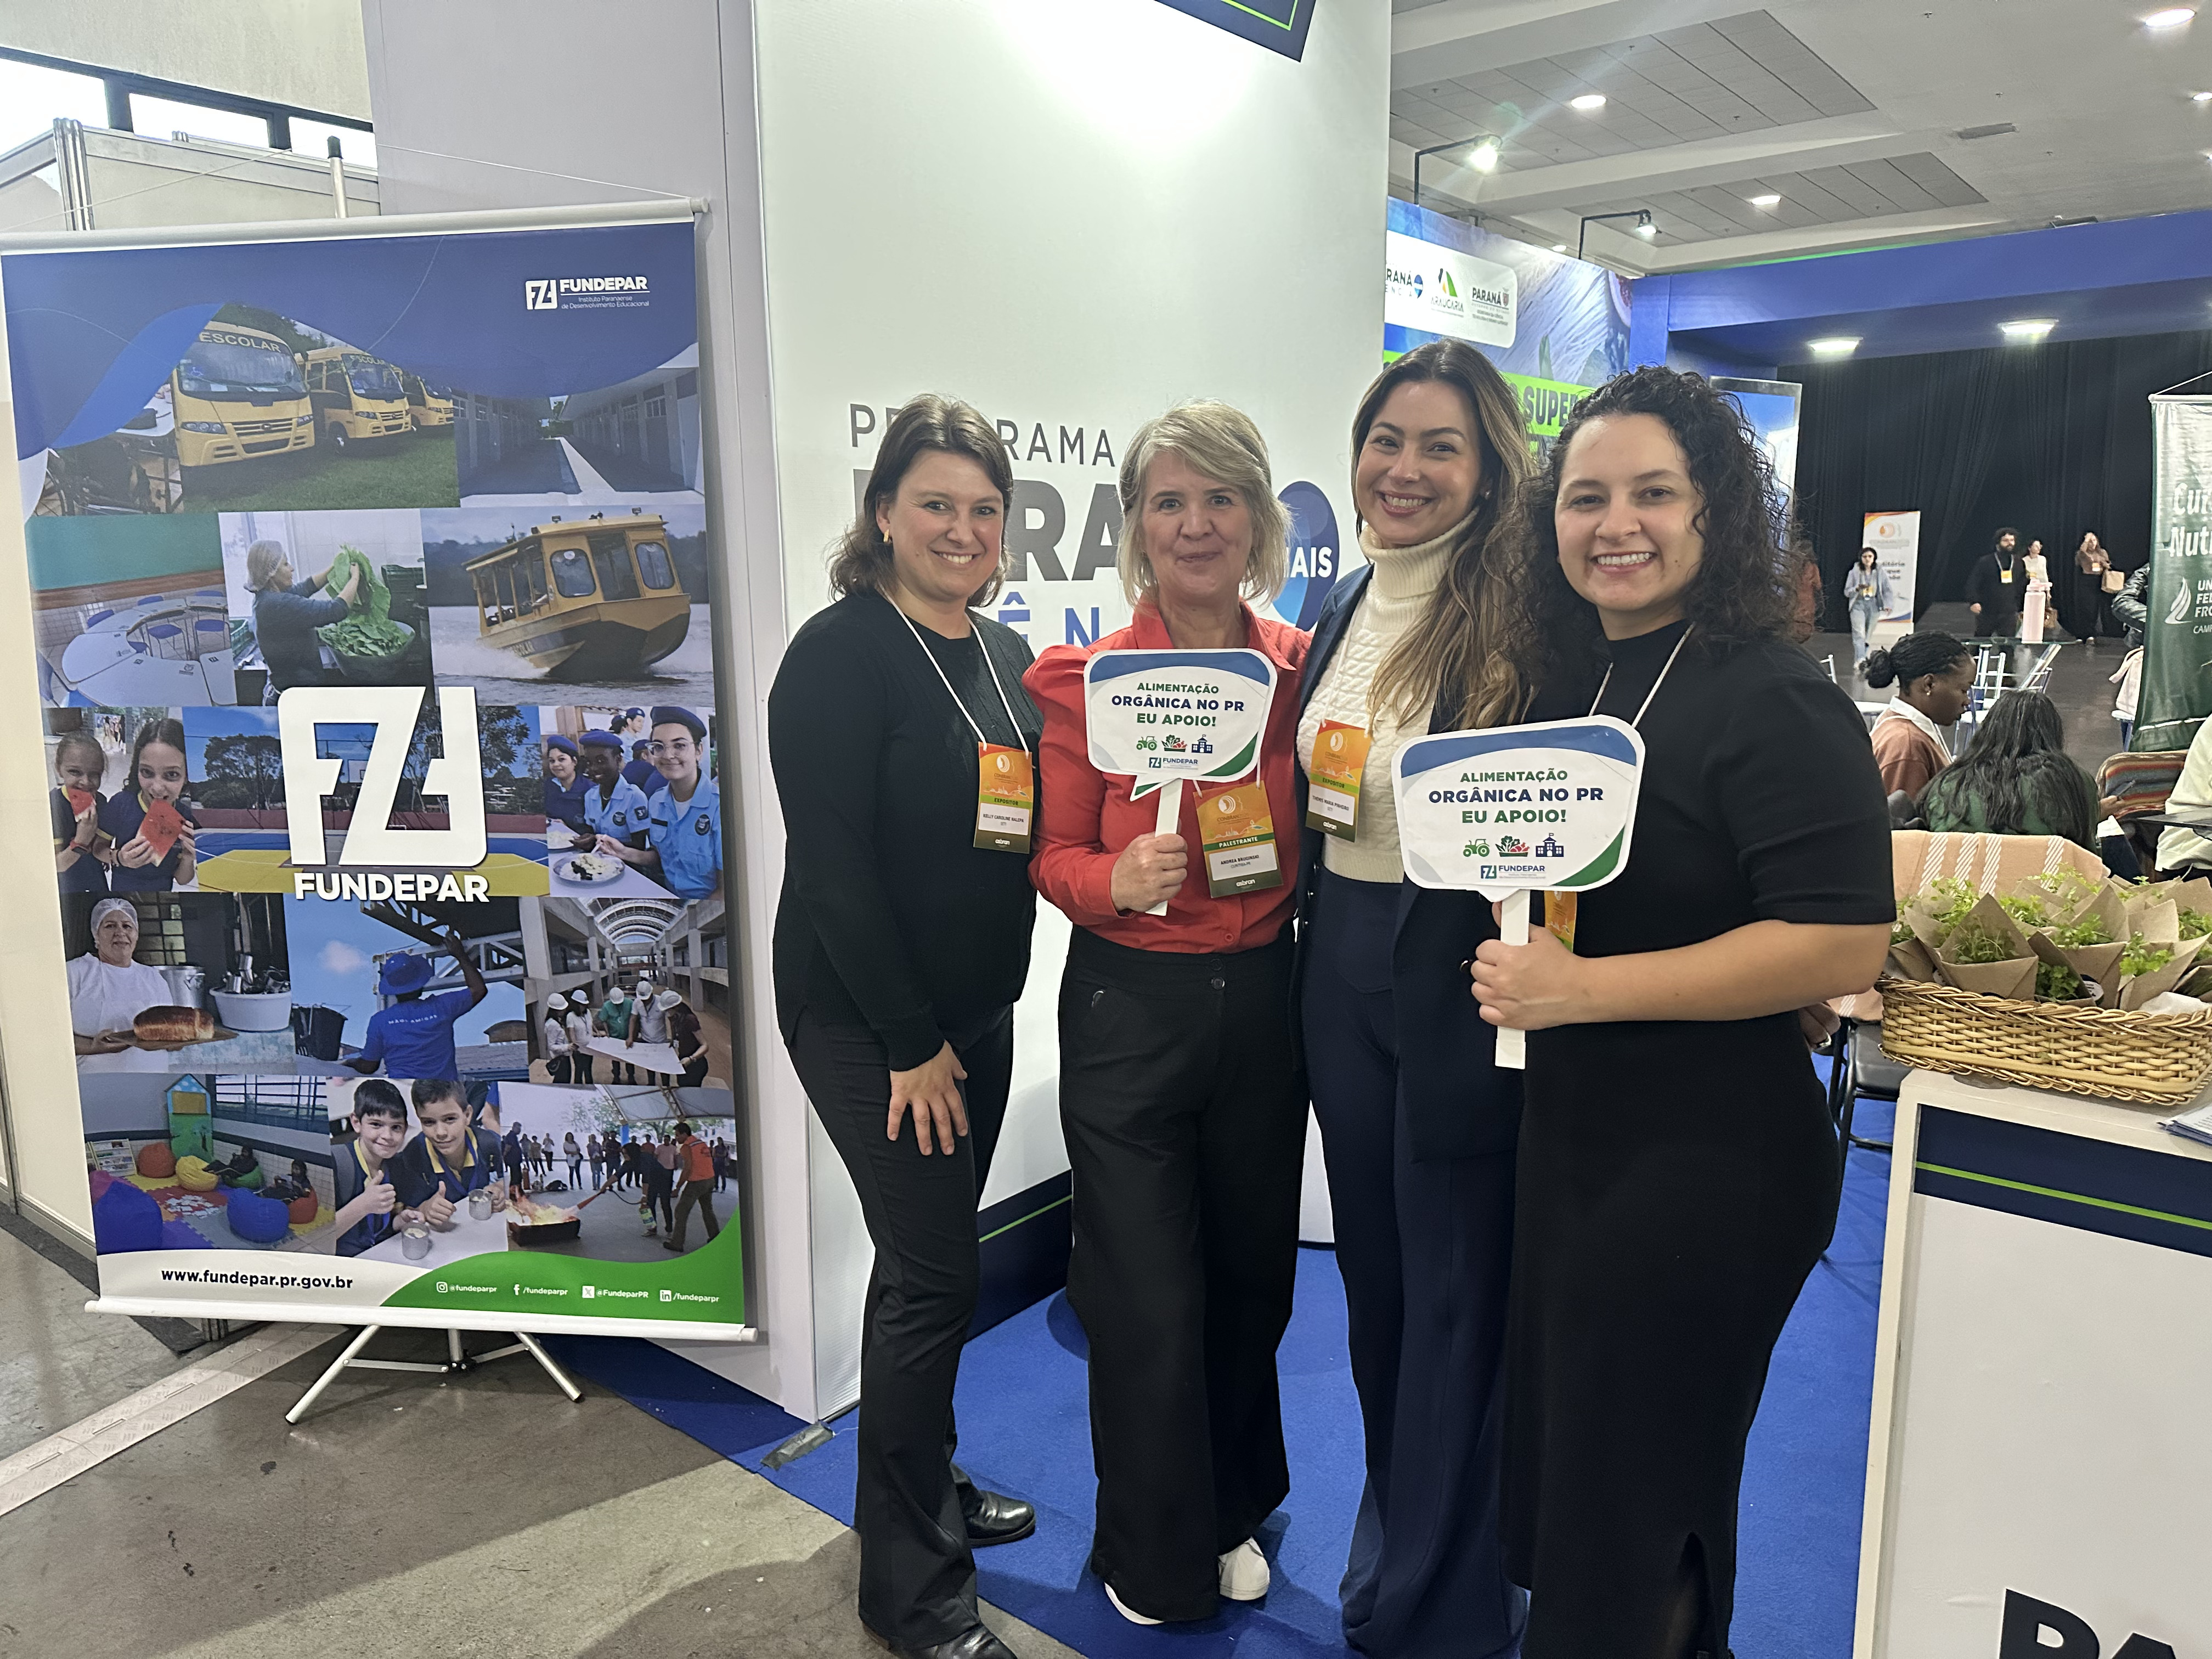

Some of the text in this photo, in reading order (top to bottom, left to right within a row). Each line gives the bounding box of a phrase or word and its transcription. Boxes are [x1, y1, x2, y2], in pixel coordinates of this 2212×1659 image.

[560, 276, 648, 292] FUNDEPAR
[1472, 287, 1502, 306] PARANÁ
[199, 332, 281, 353] ESCOLAR
[850, 403, 1116, 467] PRAMA
[1284, 546, 1333, 578] AIS
[1137, 683, 1219, 694] ALIMENTAÇÃO
[1111, 695, 1245, 711] ORGÂNICA NO PR
[1136, 713, 1216, 727] EU APOIO!
[1460, 768, 1568, 783] ALIMENTAÇÃO
[1429, 787, 1604, 803] ORGÂNICA NO PR
[1462, 809, 1567, 823] EU APOIO!
[1219, 836, 1258, 848] PALESTRANTE
[294, 872, 490, 902] FUNDEPAR
[161, 1269, 353, 1289] www.fundepar.pr.gov.br
[449, 1284, 497, 1293] @fundeparpr
[522, 1286, 568, 1296] /fundeparpr
[596, 1289, 648, 1299] @FundeparPR
[673, 1292, 720, 1303] /fundeparpr
